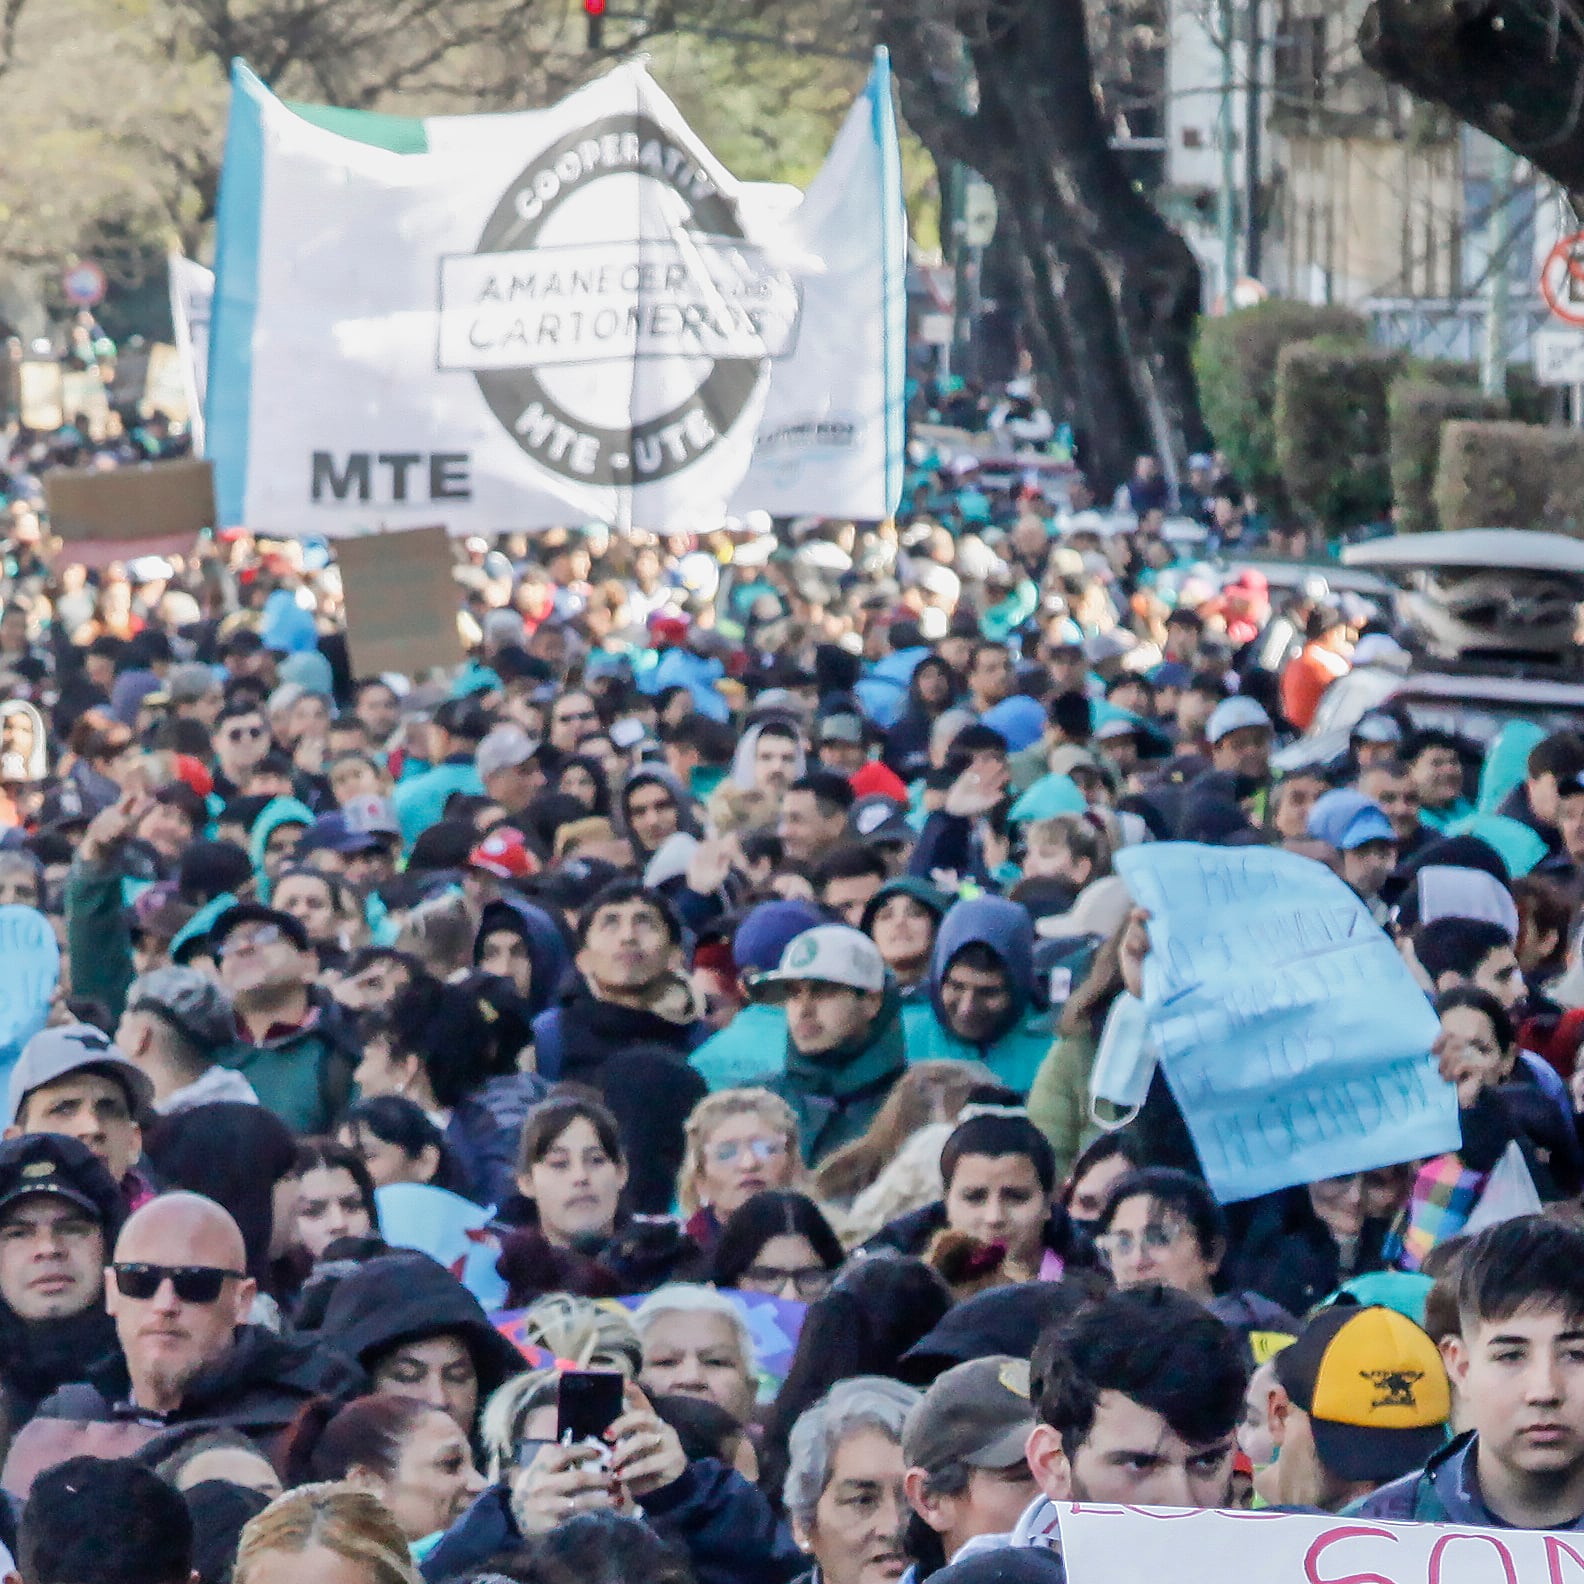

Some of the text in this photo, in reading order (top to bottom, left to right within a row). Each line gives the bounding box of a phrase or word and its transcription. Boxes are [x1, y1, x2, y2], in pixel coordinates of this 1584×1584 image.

[477, 261, 689, 303] AMANECER
[516, 401, 601, 474] MTE
[632, 407, 717, 472] UTE
[312, 451, 472, 500] MTE
